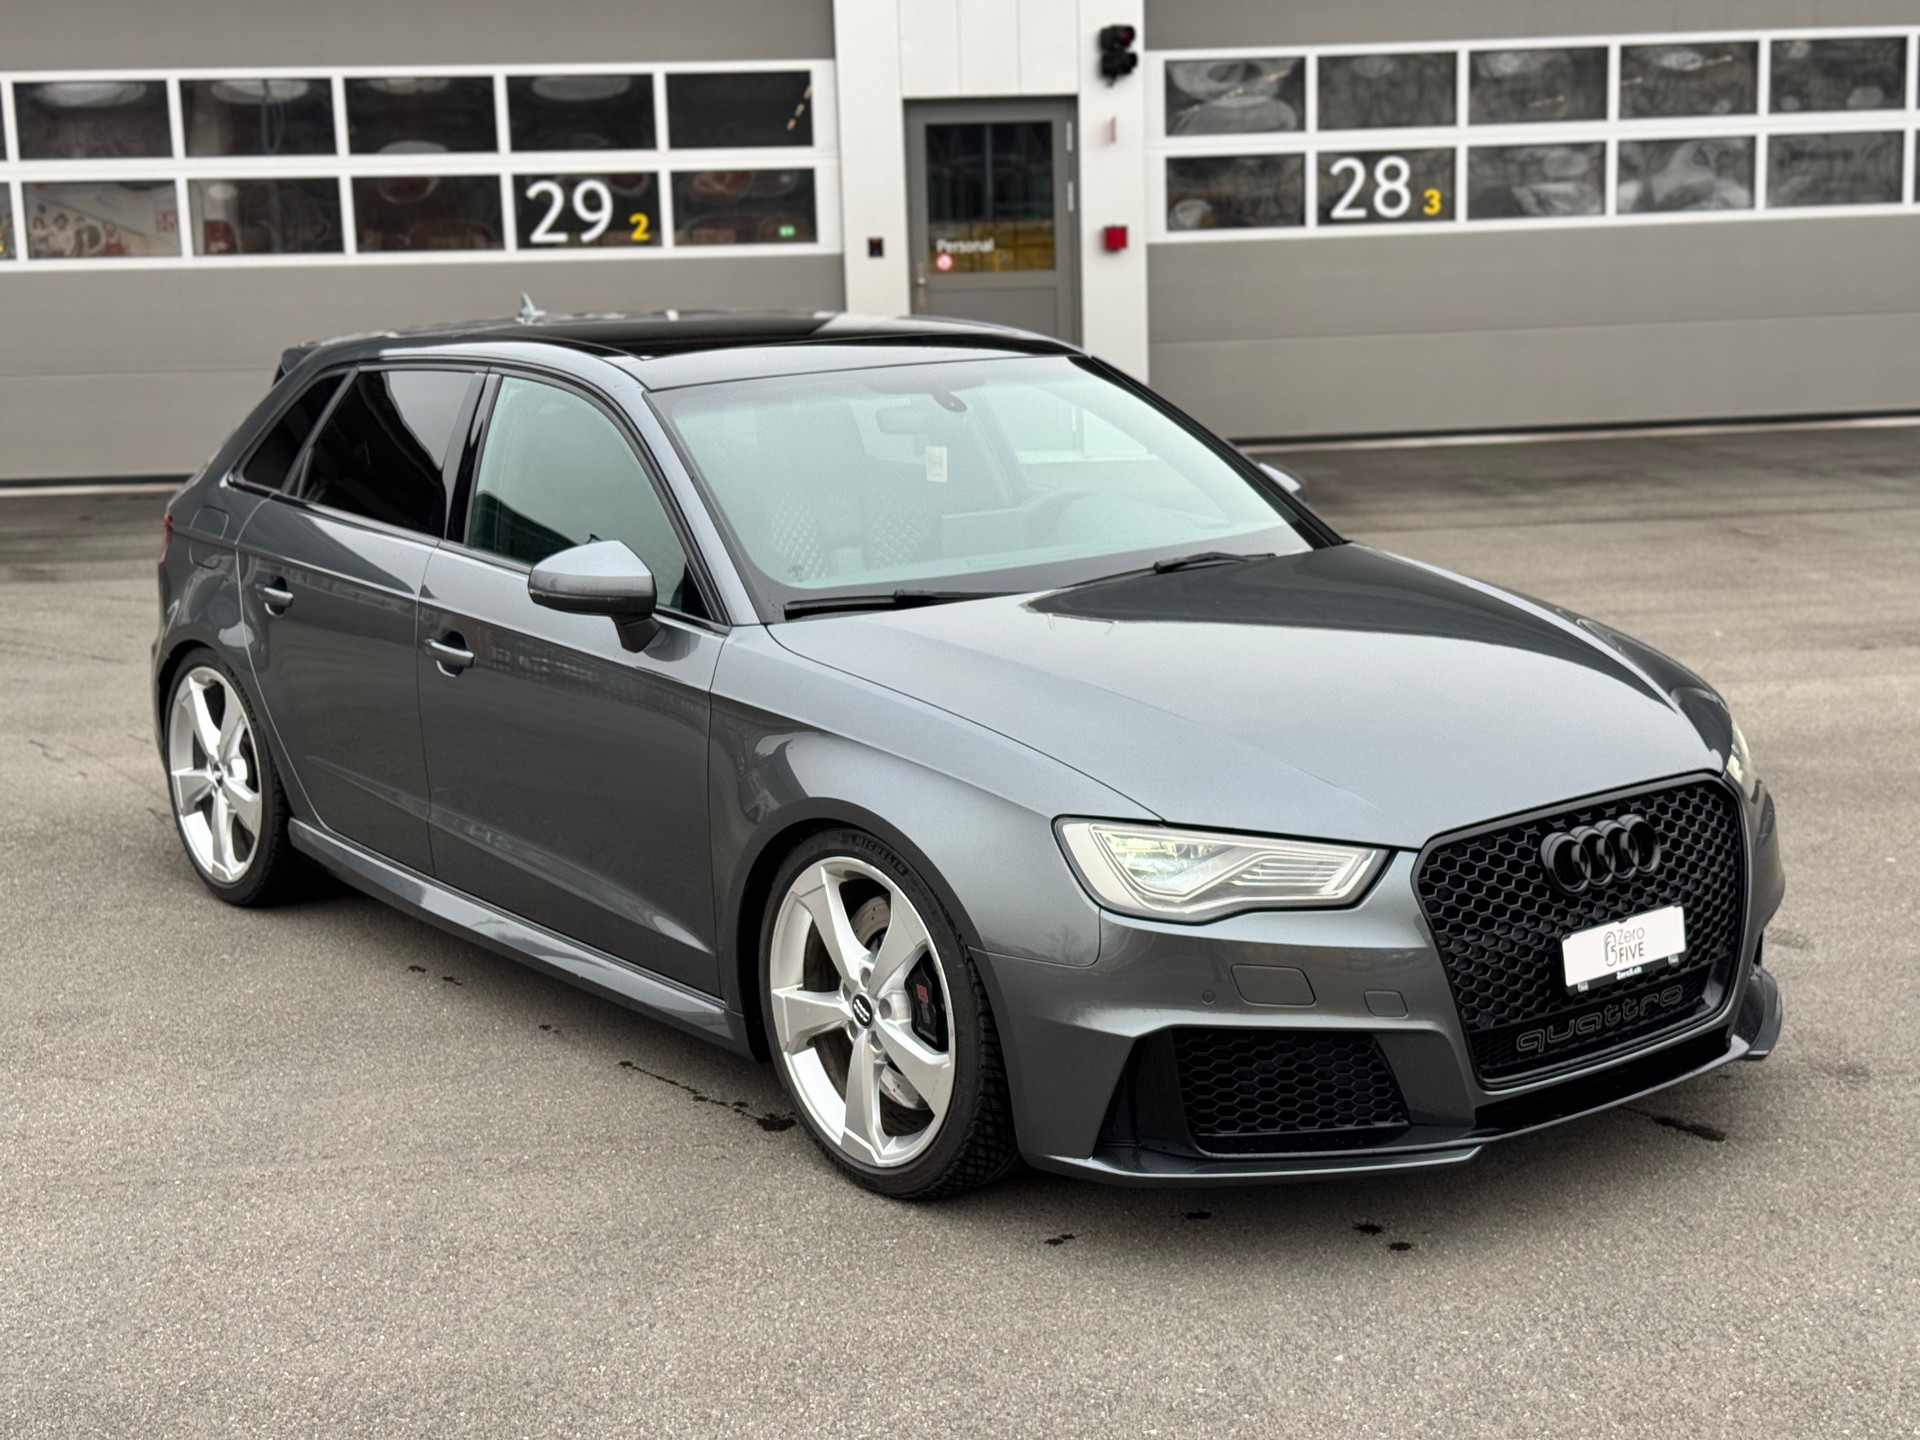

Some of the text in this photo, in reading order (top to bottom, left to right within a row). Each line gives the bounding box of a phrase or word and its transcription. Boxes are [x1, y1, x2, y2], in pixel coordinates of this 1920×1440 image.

[1329, 155, 1442, 219] 28 3
[525, 179, 650, 243] 29 2
[936, 237, 994, 254] Personal
[1617, 926, 1645, 945] Zero
[1619, 941, 1645, 964] FIVE
[1517, 984, 1683, 1053] quattro
